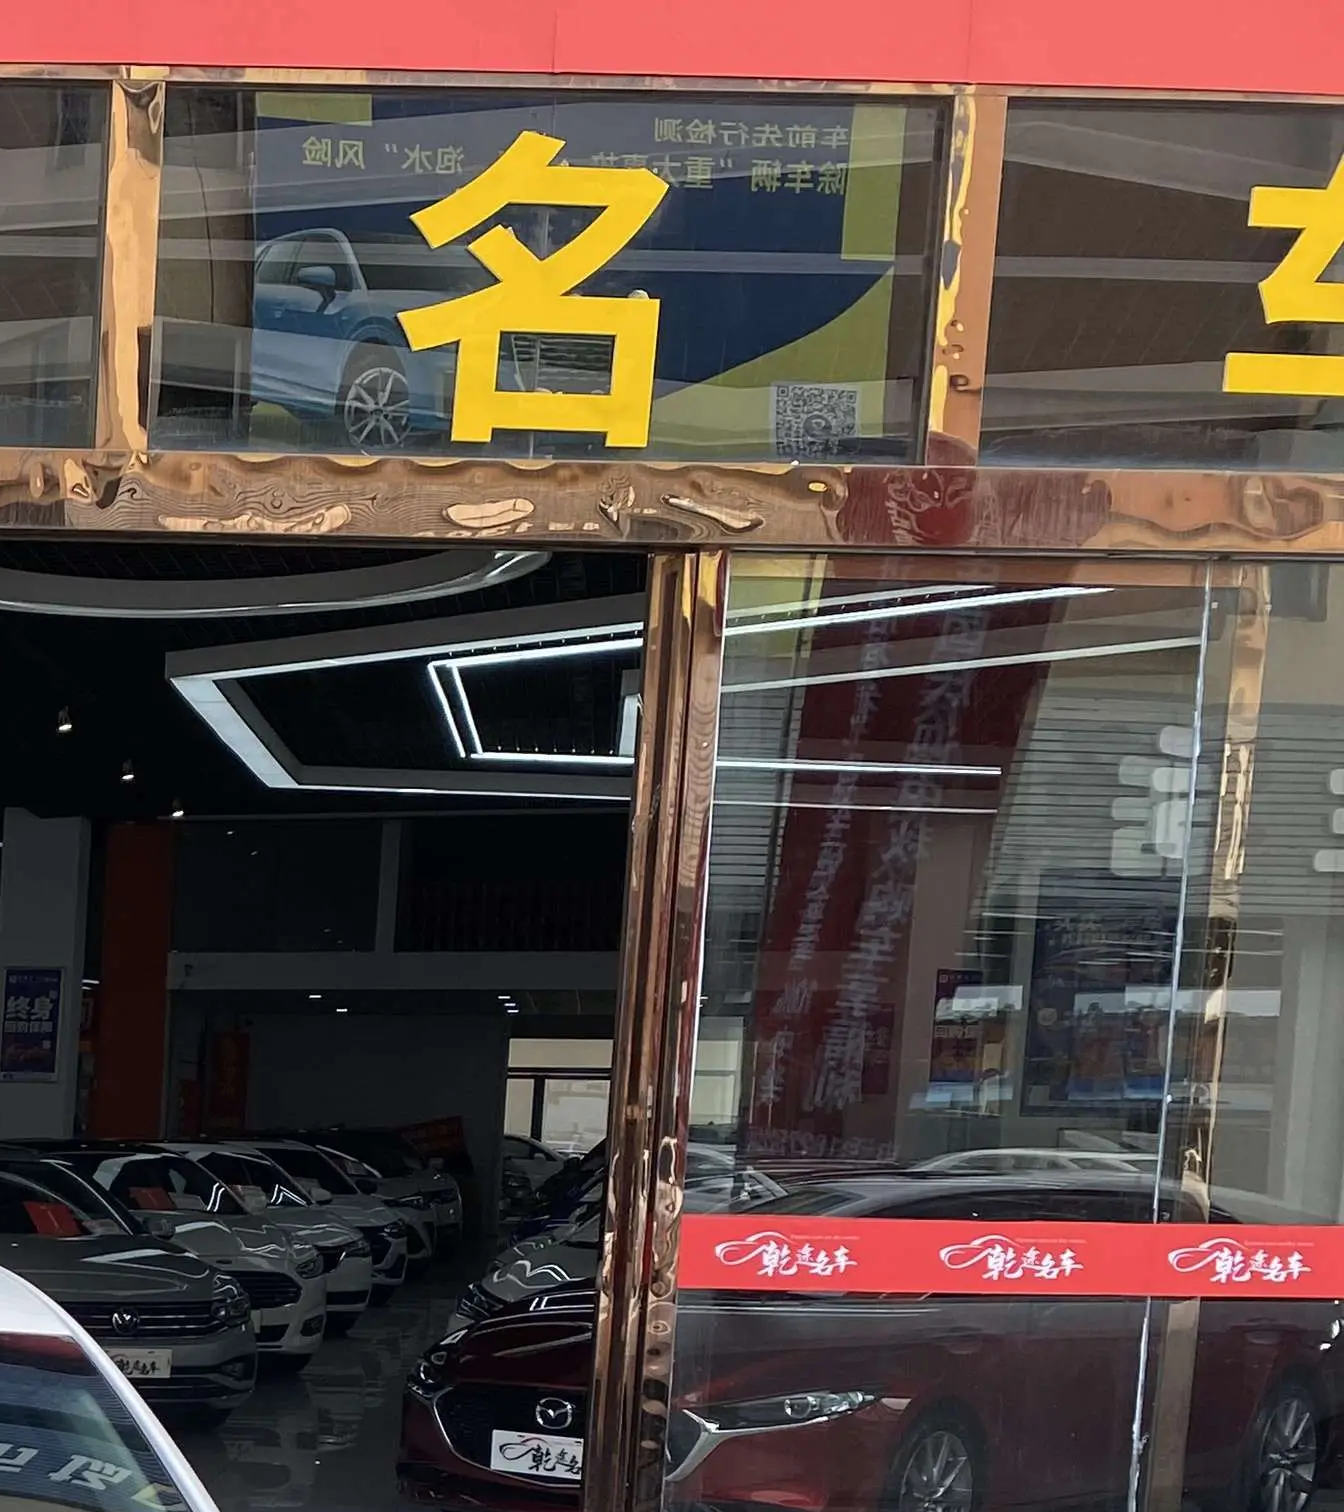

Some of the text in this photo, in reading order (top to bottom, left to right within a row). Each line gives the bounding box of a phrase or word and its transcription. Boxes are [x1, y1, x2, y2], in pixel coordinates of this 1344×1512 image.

[757, 1239, 859, 1277] 乾途名车
[981, 1243, 1085, 1281] 乾途名车
[1209, 1246, 1313, 1284] 乾途名车
